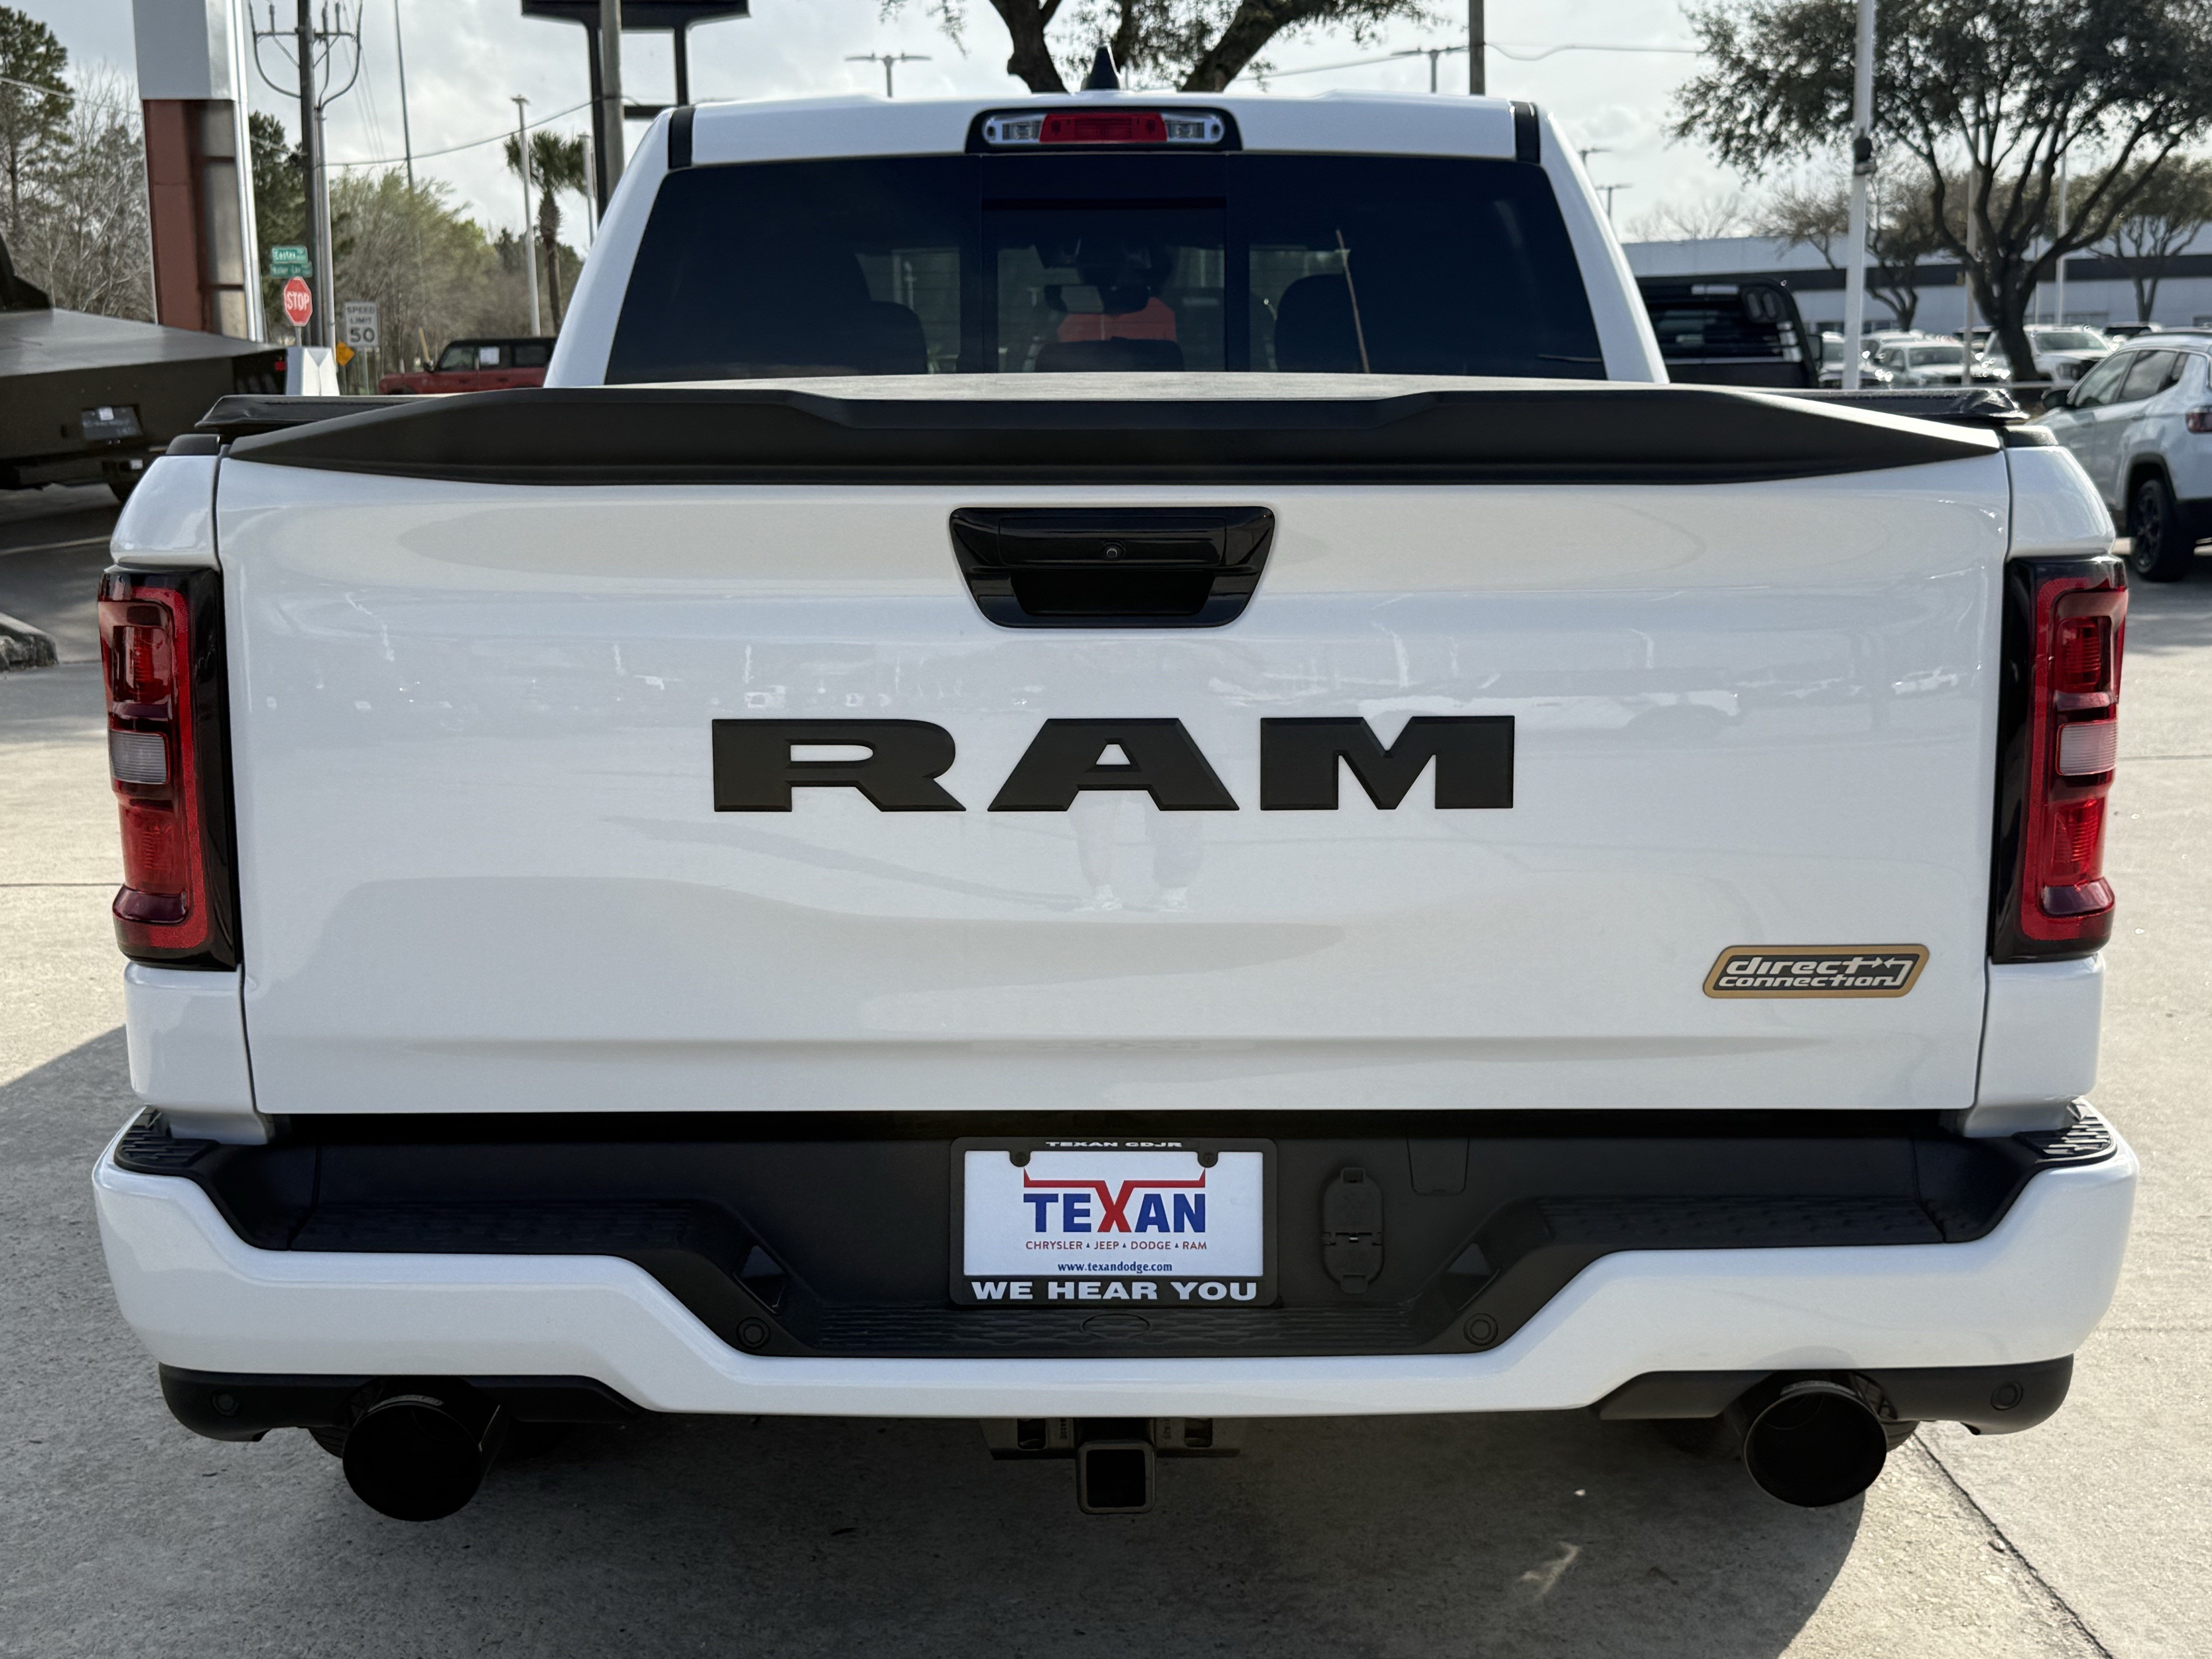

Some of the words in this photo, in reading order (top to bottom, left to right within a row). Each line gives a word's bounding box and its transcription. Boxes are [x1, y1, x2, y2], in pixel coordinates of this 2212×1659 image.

[287, 292, 310, 311] STOP
[347, 306, 376, 314] SPEED
[350, 327, 375, 343] 50
[712, 715, 1515, 812] RAM
[1726, 957, 1882, 975] direct
[1719, 974, 1908, 988] connection
[1024, 1180, 1206, 1232] TEXAN
[1025, 1241, 1083, 1250] CHRYSLER
[1094, 1241, 1119, 1250] JEEP
[1131, 1241, 1171, 1250] DODGE
[1182, 1241, 1207, 1250] RAM
[1058, 1261, 1173, 1274] www.texandodge.com
[971, 1281, 1033, 1300] WE
[1048, 1281, 1158, 1300] HEAR
[1170, 1281, 1257, 1300] YOU
